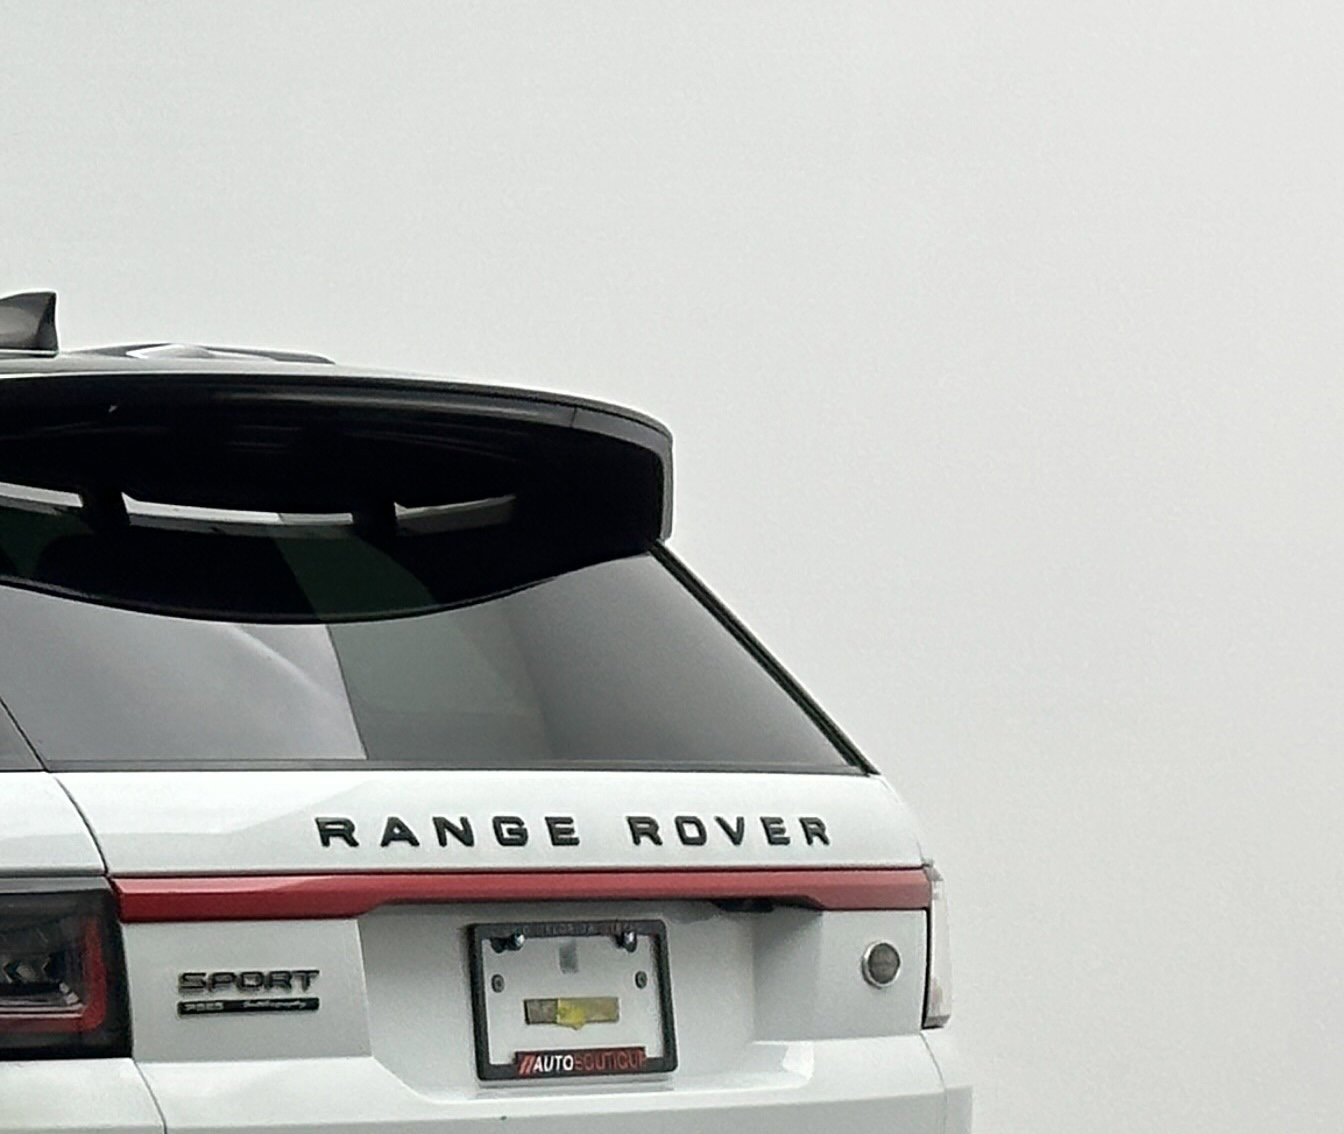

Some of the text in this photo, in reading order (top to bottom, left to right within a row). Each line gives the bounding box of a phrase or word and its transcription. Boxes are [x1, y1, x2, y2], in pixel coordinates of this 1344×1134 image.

[314, 815, 831, 848] RANGE ROVER
[178, 969, 320, 993] SPORT
